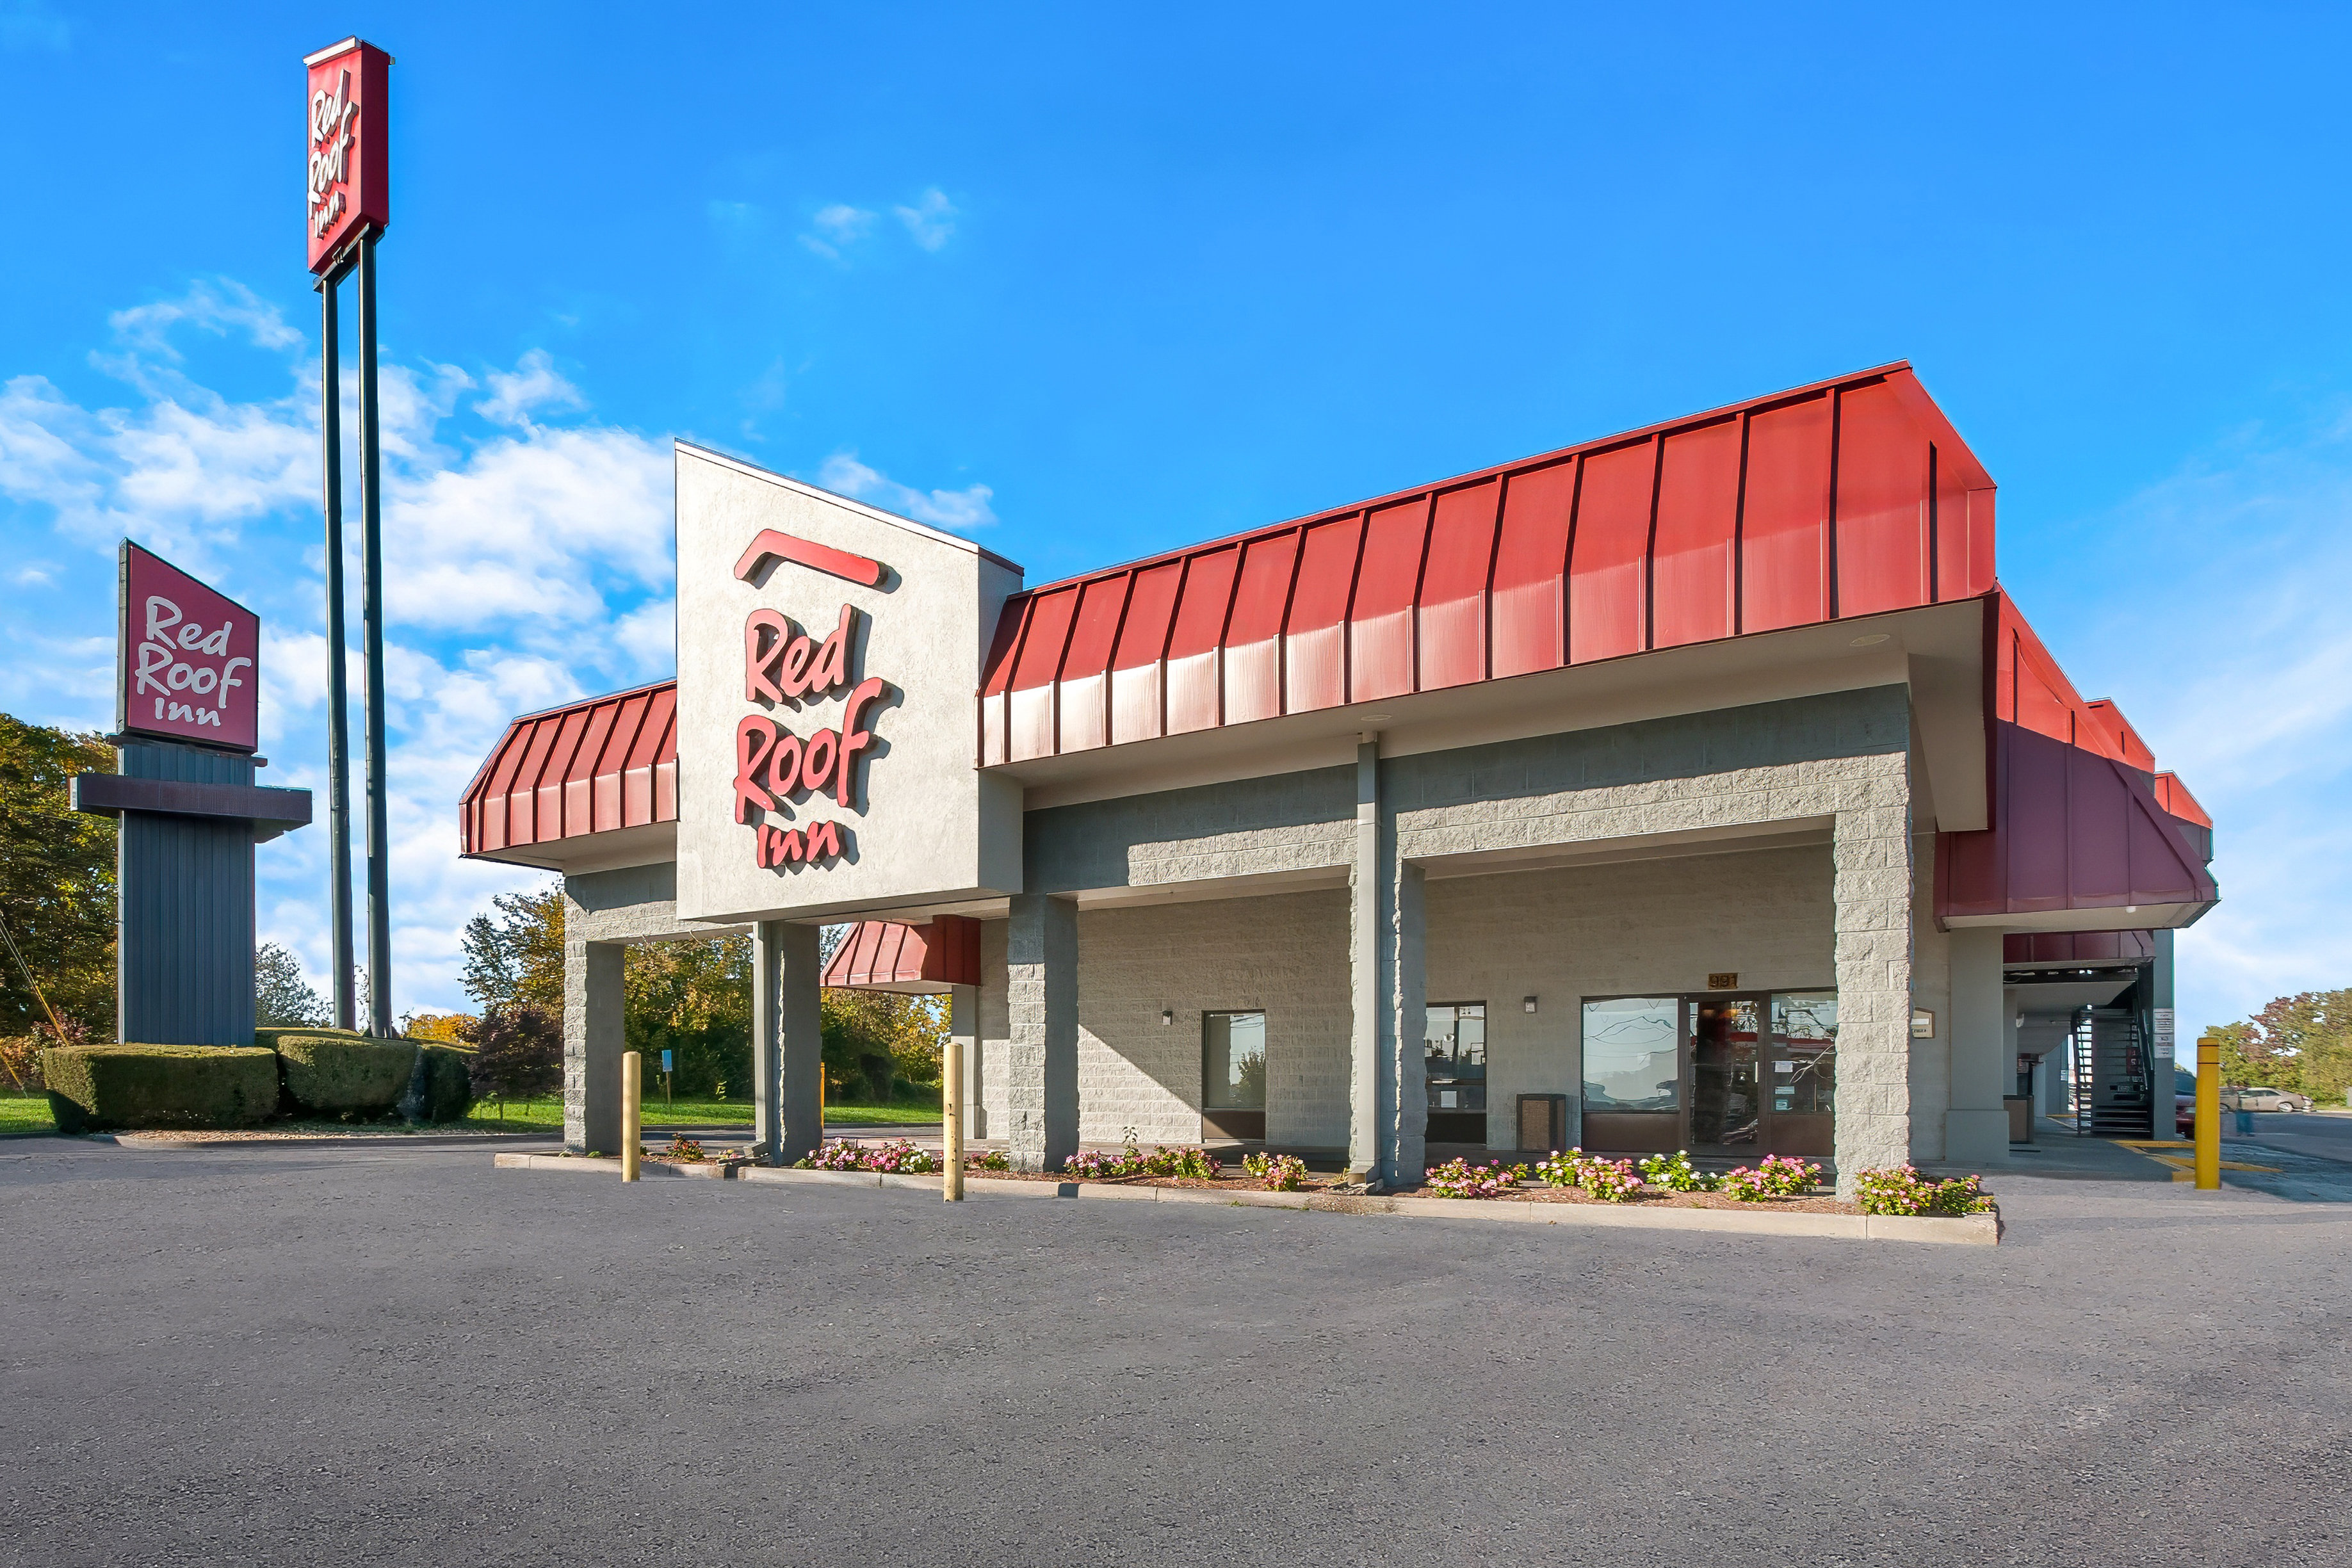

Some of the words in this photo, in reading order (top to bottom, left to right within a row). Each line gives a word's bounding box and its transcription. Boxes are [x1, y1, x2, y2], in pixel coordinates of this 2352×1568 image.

[311, 69, 347, 148] Red
[308, 101, 355, 219] Roof
[314, 190, 342, 238] Inn
[146, 596, 232, 656] Red
[745, 604, 854, 703] Red
[134, 642, 252, 709] Roof
[156, 697, 221, 727] Inn
[733, 677, 884, 824] Roof
[757, 820, 841, 869] Inn
